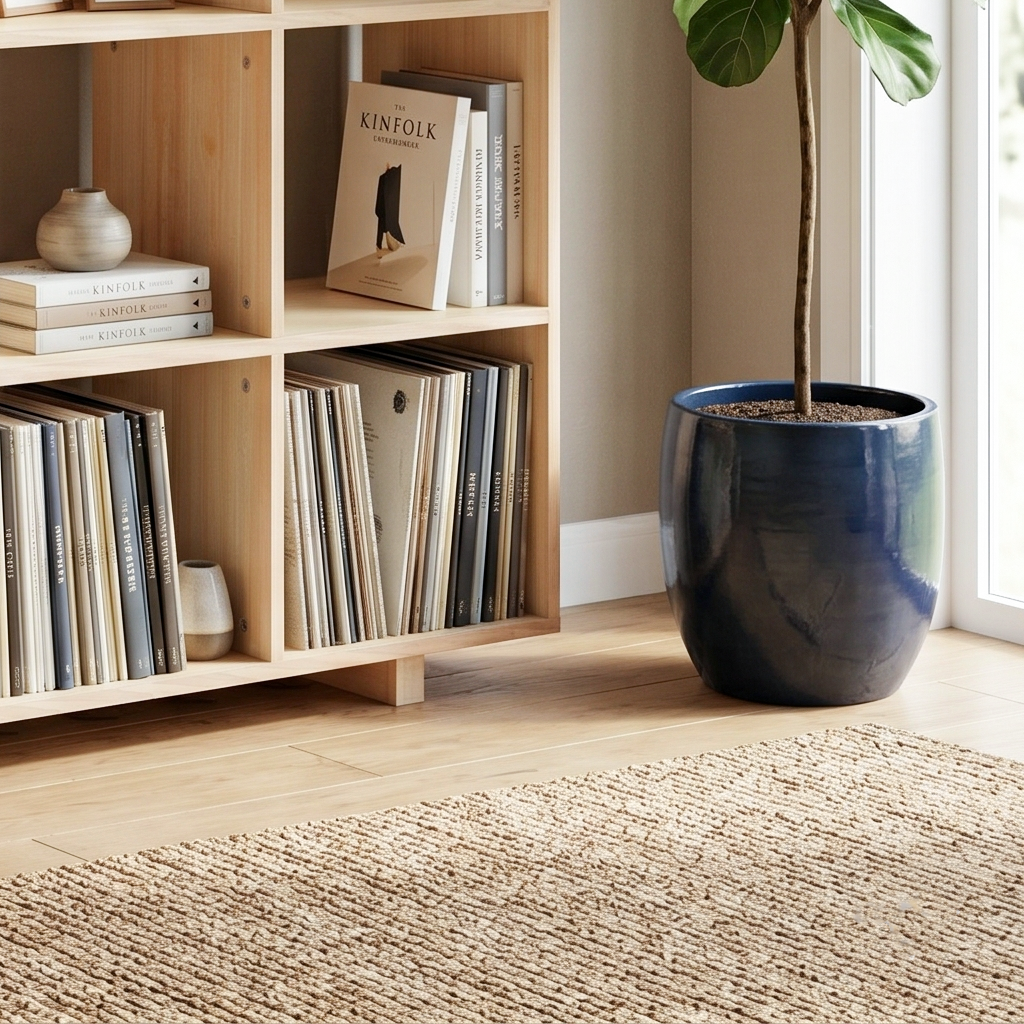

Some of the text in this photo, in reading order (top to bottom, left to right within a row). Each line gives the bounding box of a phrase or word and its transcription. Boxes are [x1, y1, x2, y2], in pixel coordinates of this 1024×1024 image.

[360, 112, 437, 140] KINFOLK
[93, 281, 146, 295] KINFOLK
[99, 304, 147, 318] KINFOLK
